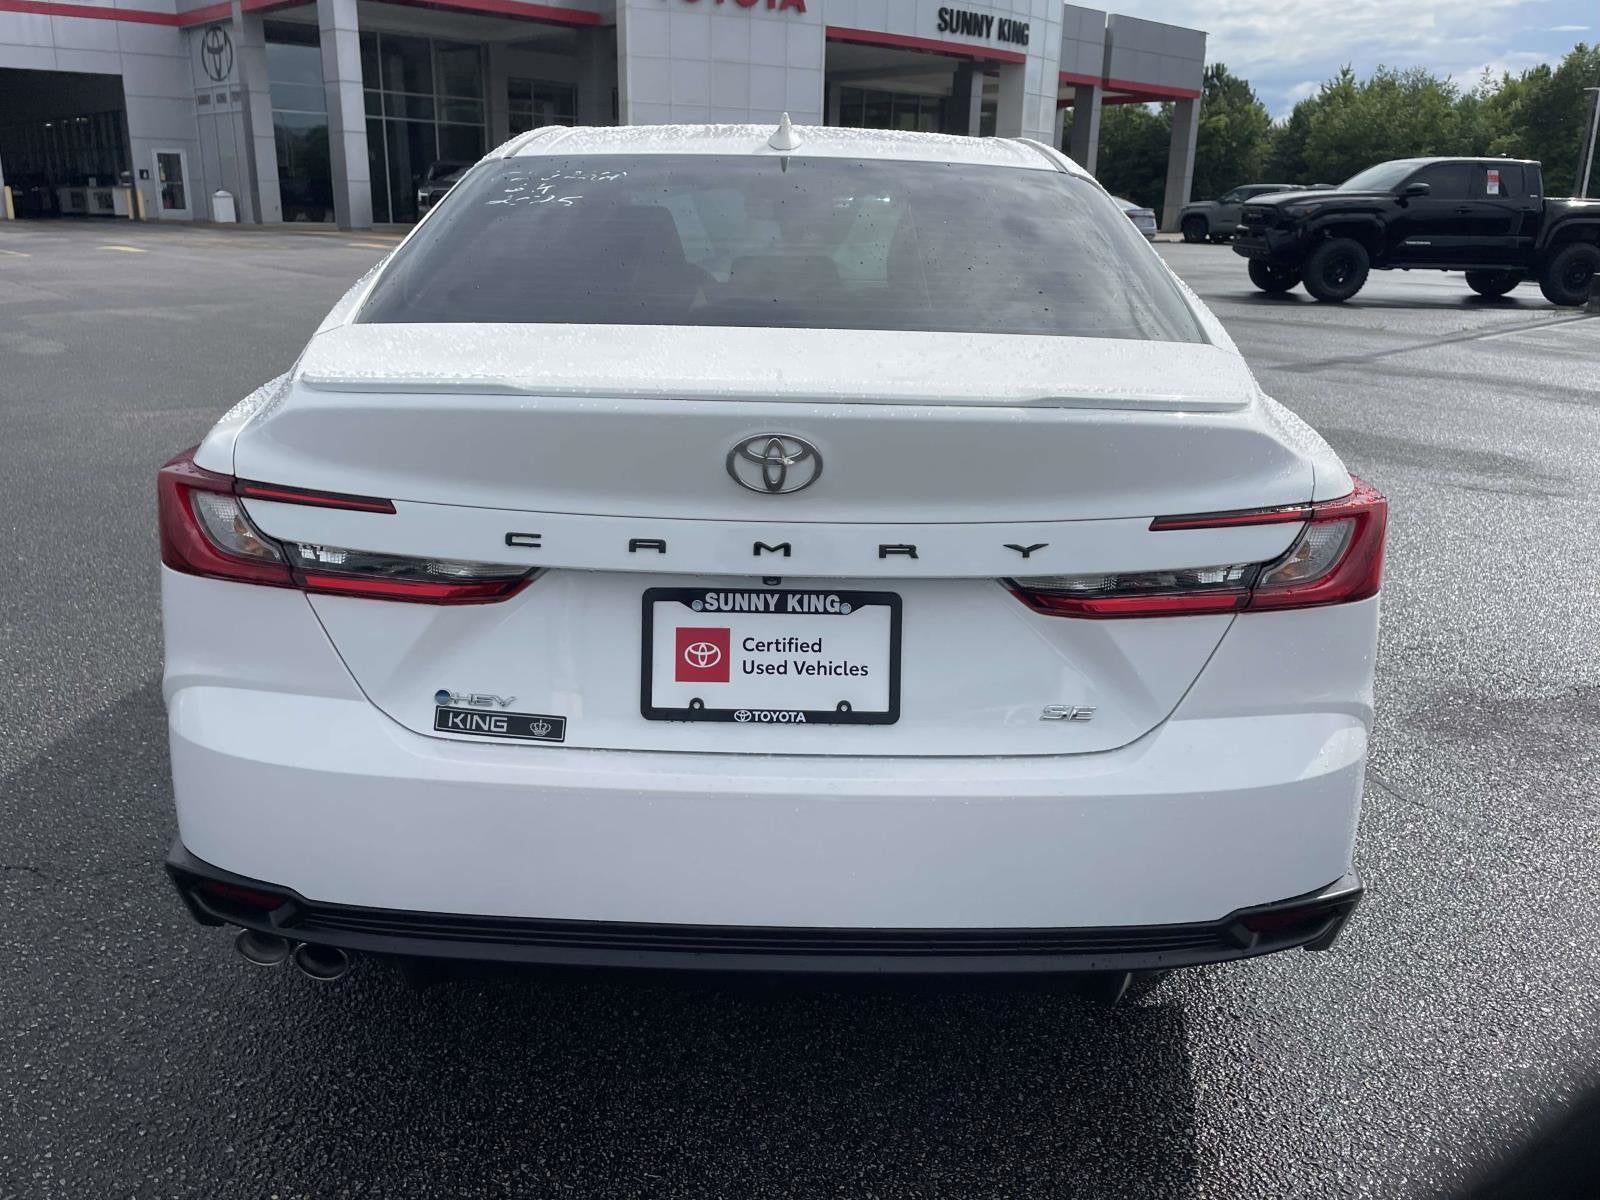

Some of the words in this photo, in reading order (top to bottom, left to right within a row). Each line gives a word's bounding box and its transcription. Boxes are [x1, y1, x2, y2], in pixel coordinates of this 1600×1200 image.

[937, 6, 995, 39] SUNNY
[997, 17, 1030, 46] KING
[504, 531, 1050, 559] CAMRY
[704, 592, 780, 612] SUNNY
[787, 594, 841, 613] KING
[742, 637, 822, 653] Certified
[742, 659, 788, 675] Used
[793, 660, 869, 676] Vehicles
[450, 692, 517, 707] HEV
[752, 711, 807, 722] TOYOTA
[1039, 704, 1097, 721] SE
[448, 712, 508, 732] KING
